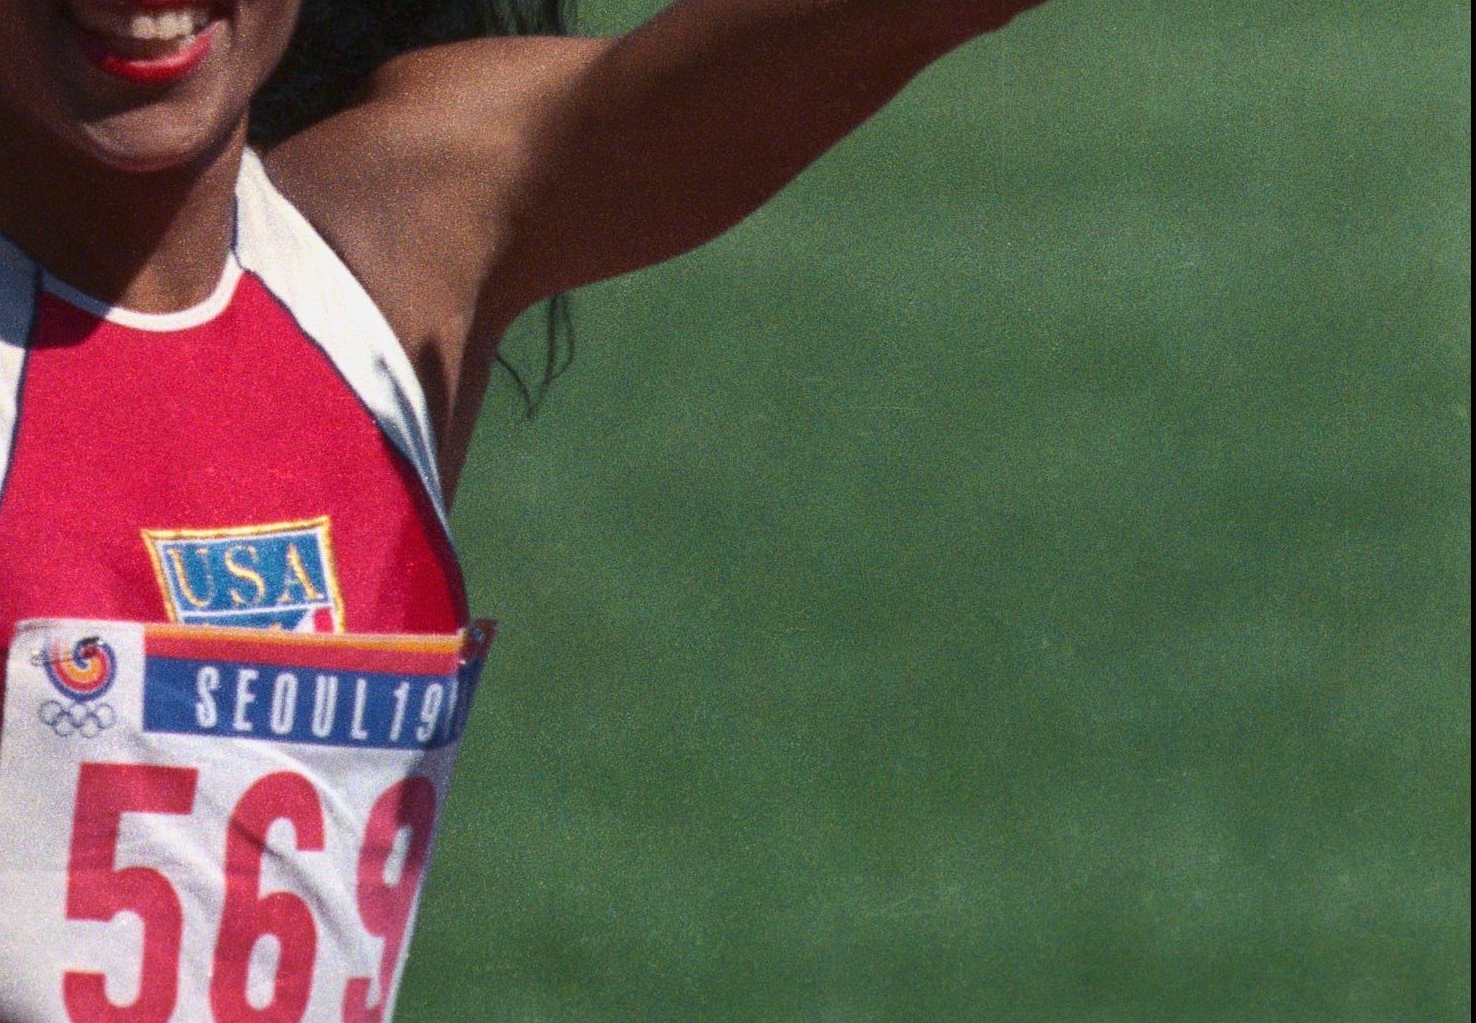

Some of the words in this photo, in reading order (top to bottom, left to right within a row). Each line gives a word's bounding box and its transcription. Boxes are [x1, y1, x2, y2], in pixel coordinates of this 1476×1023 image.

[167, 543, 325, 608] USA
[195, 665, 369, 741] SEOUL
[388, 681, 459, 742] 19
[62, 761, 436, 1023] 569
